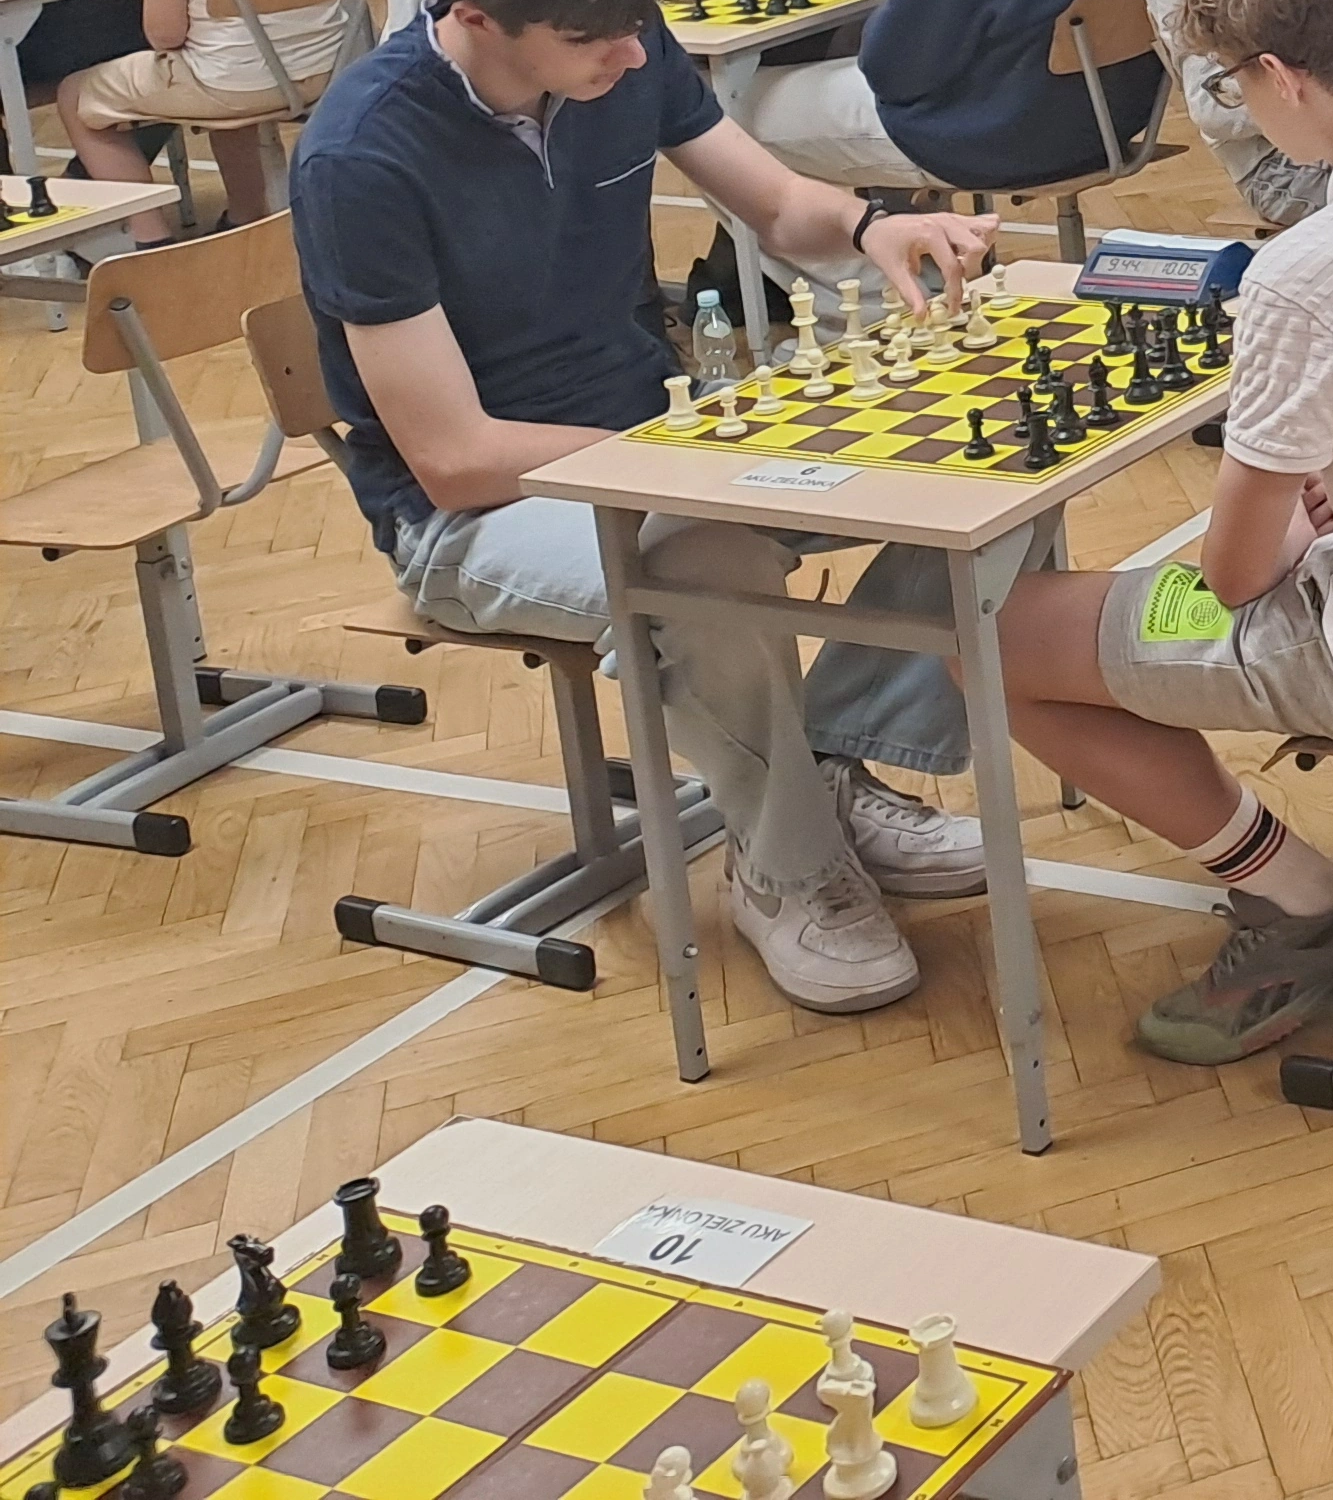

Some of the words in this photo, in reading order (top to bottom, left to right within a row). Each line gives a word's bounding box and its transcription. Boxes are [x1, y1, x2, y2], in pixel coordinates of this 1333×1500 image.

[799, 465, 822, 476] 6
[743, 473, 772, 482] AKU
[769, 475, 836, 488] ZIELONKA
[740, 1222, 792, 1243] AKU
[649, 1233, 703, 1266] 10
